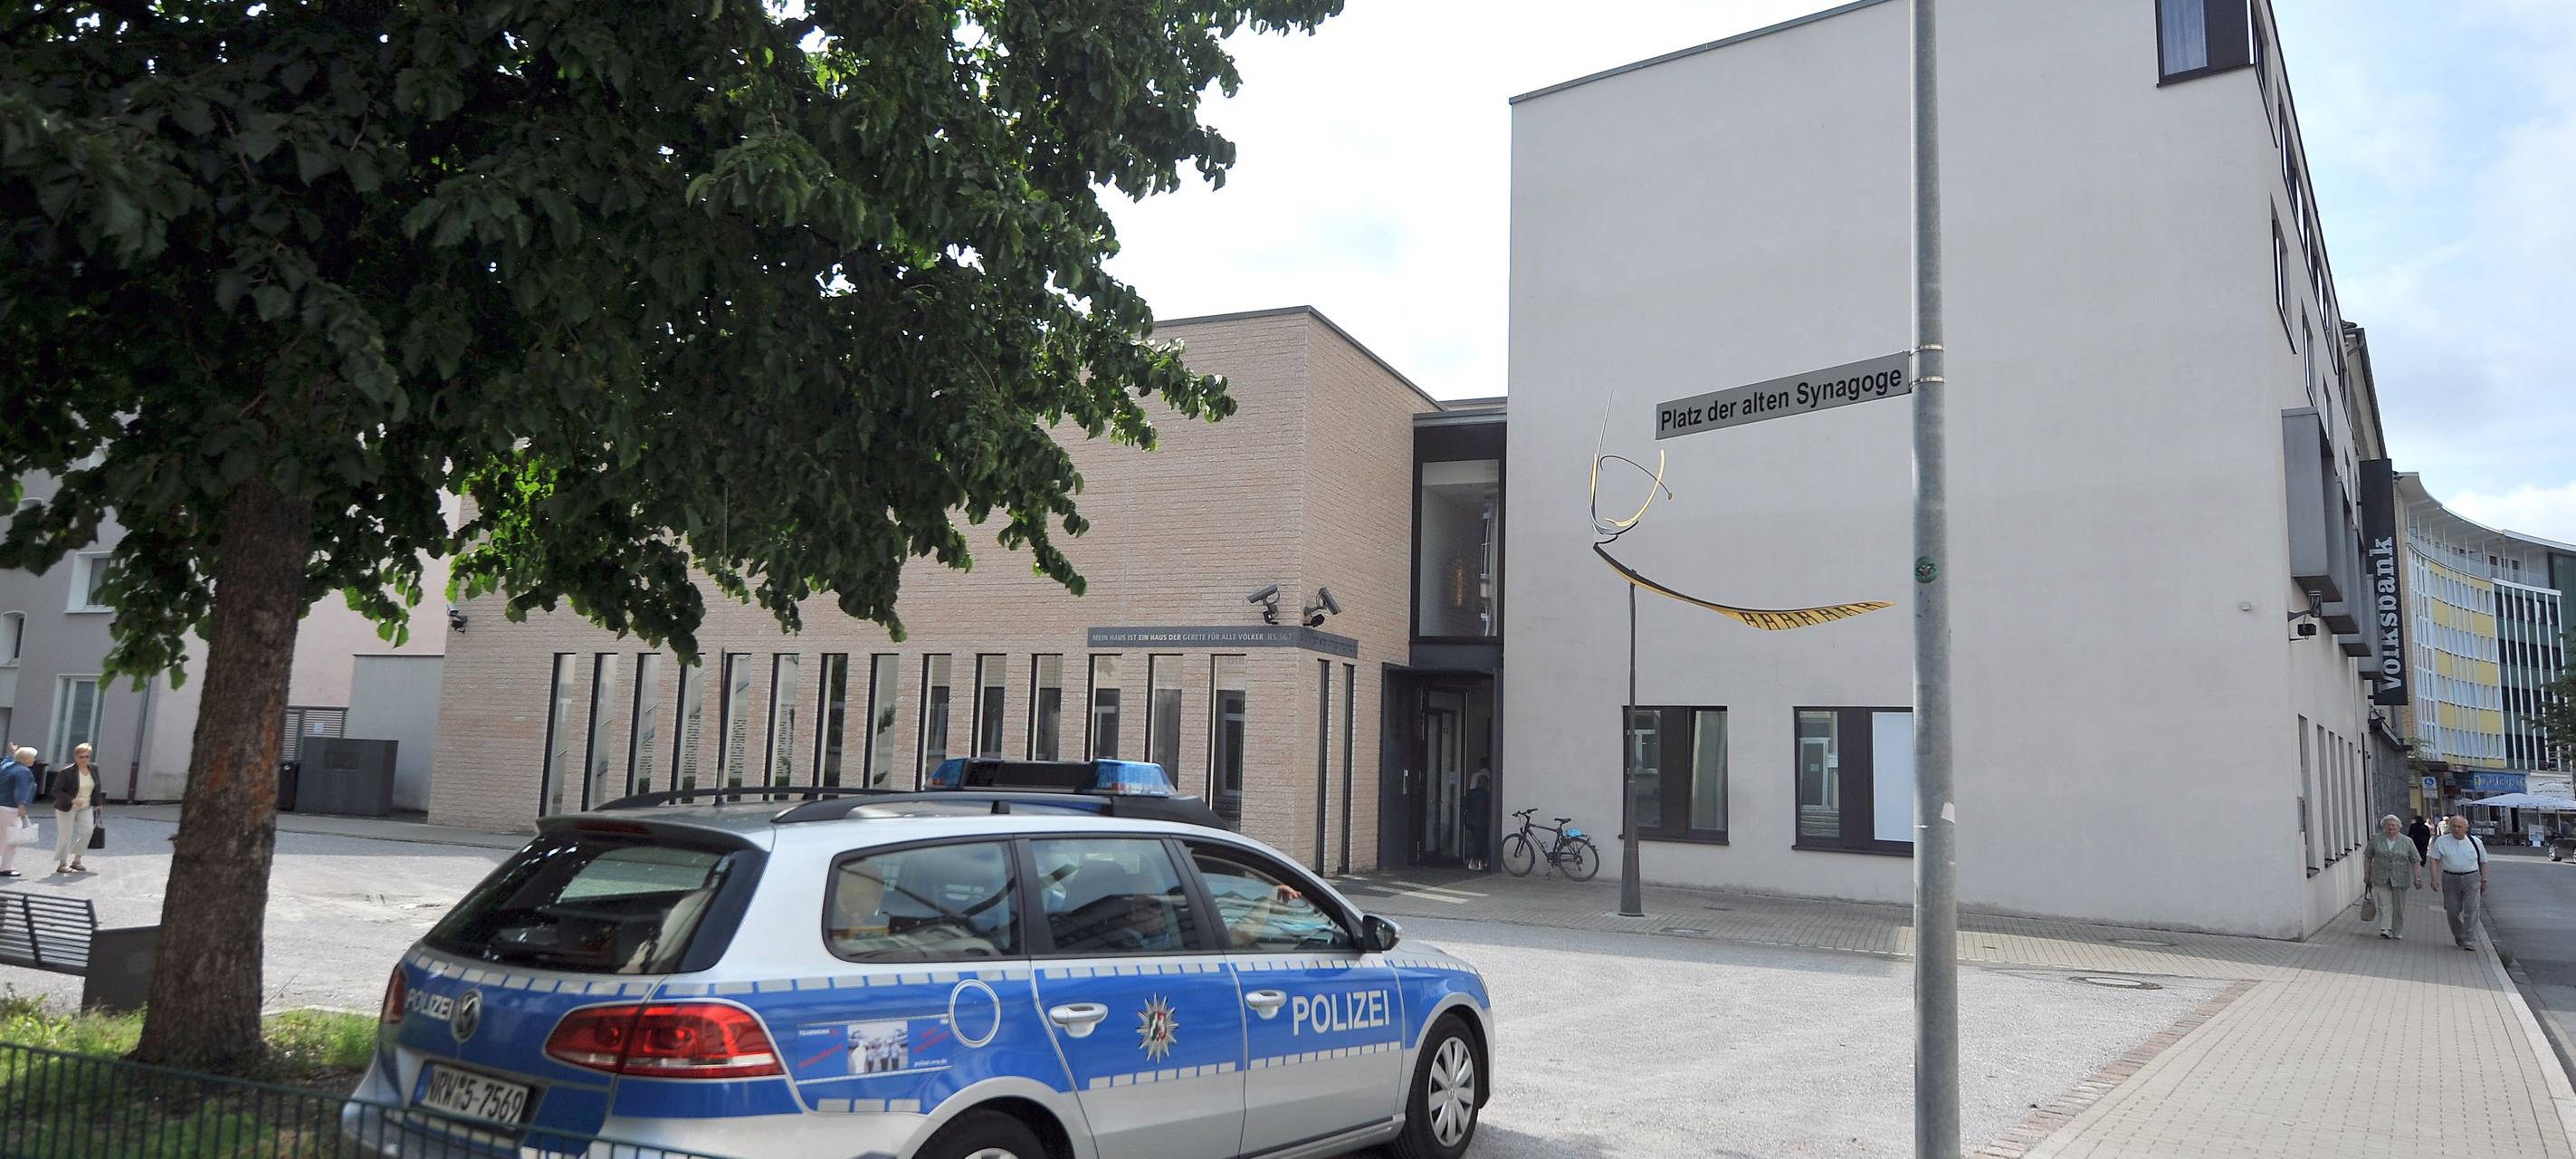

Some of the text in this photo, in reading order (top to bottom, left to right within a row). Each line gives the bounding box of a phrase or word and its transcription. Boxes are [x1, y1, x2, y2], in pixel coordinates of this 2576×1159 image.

[1661, 369, 1902, 431] Platz der alten Synagoge
[406, 988, 454, 1021] POLIZEI
[1293, 990, 1389, 1036] POLIZEI
[428, 1069, 525, 1124] NRW 5-7569
